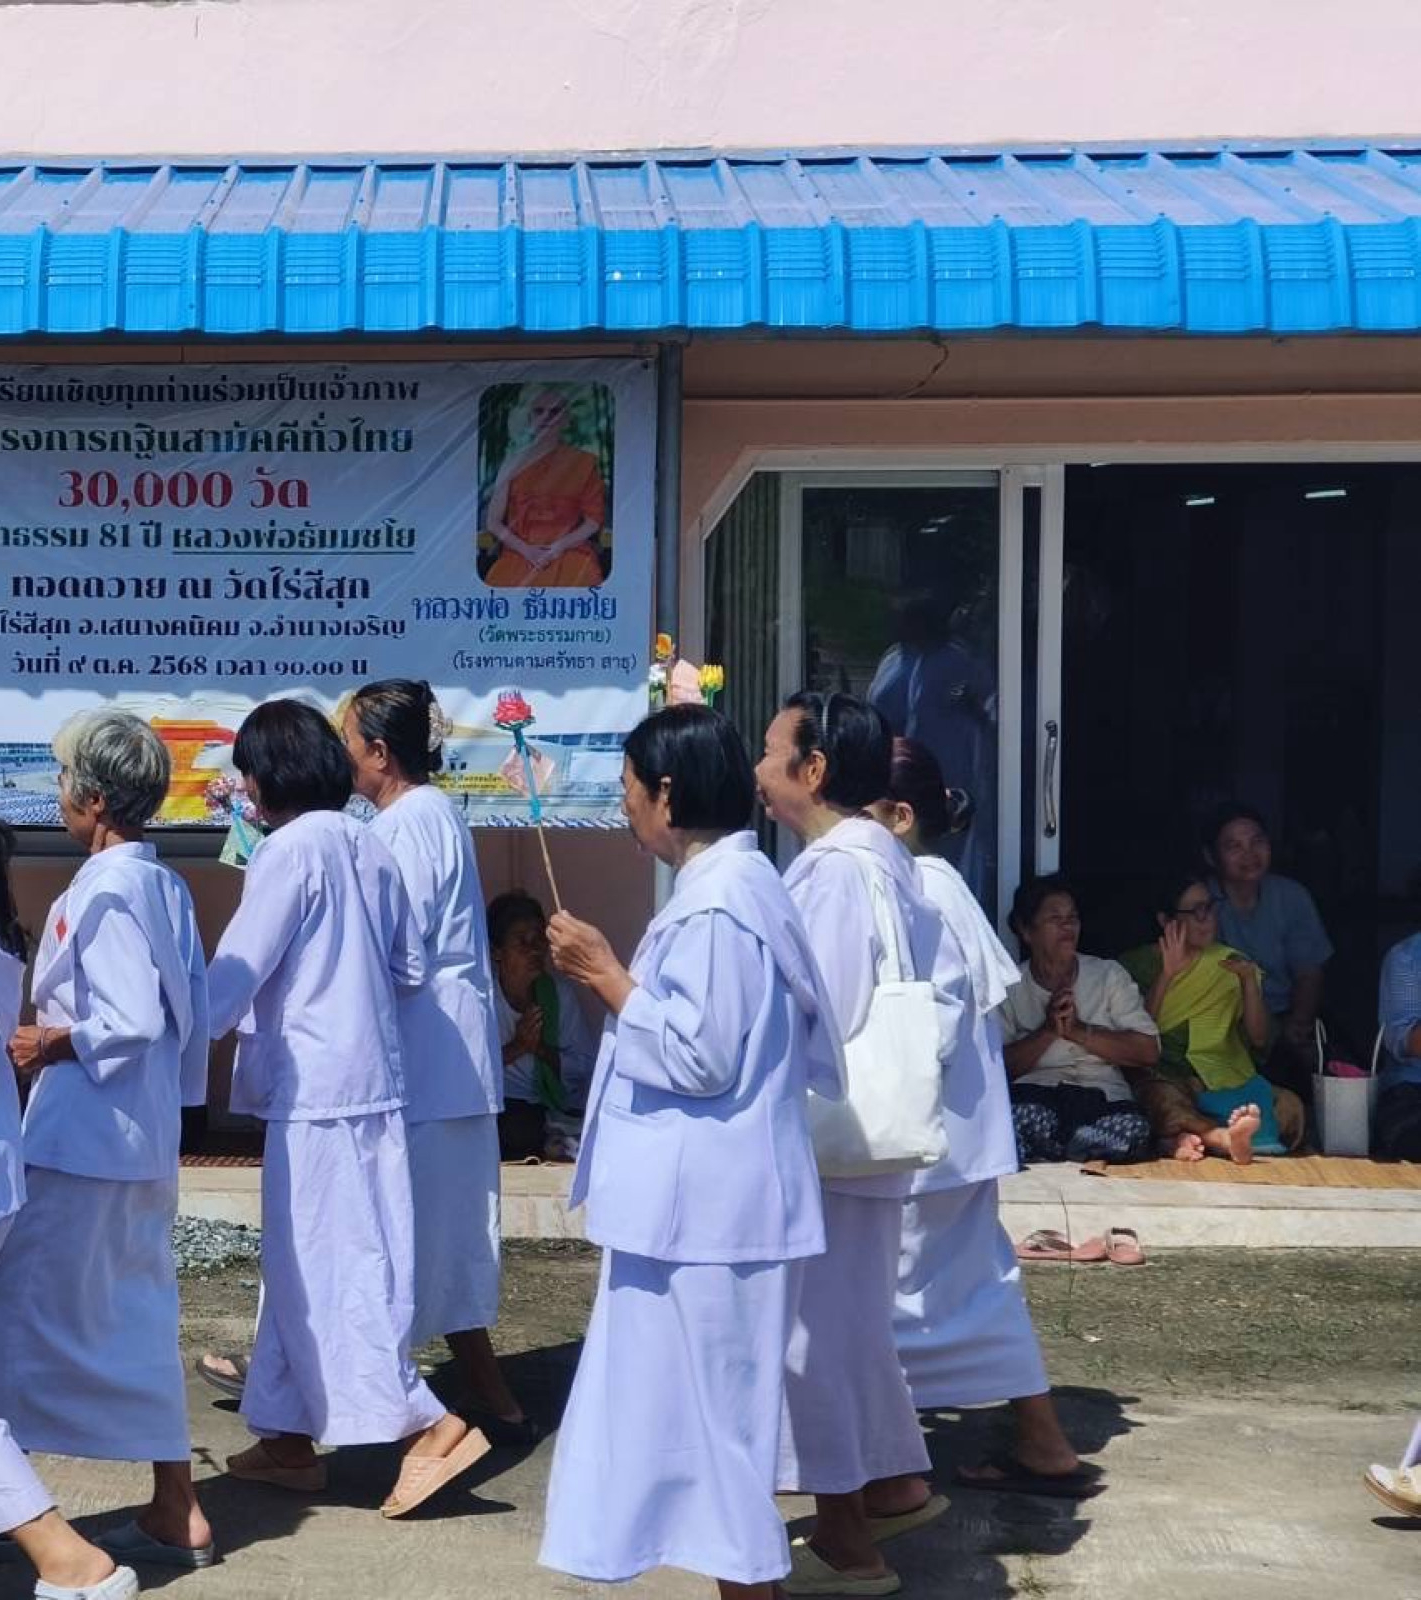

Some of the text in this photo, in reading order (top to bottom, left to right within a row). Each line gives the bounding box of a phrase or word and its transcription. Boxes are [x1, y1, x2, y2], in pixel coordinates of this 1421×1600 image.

[58, 466, 312, 514] 30,000 วัด
[98, 523, 129, 548] 81
[138, 520, 162, 549] ปี
[173, 518, 416, 550] หลวงพ่อธัมมชโย
[12, 566, 371, 609] ทอดถวาย ณ วัดไร่สีสุก
[412, 587, 617, 621] หลวงพ่อ ธัมมชโย
[78, 614, 241, 636] อ.เสนางคนิคม
[248, 614, 407, 640] จ.อำนาจเจริญ
[478, 625, 612, 644] (วัดพระธรรมกาย)
[11, 646, 60, 674] วันที่
[93, 658, 140, 674] ต.ค.
[148, 654, 208, 675] 2568
[216, 659, 267, 676] เวลา
[452, 650, 638, 675] (โรงทานตามศรัทธา สาธุ)
